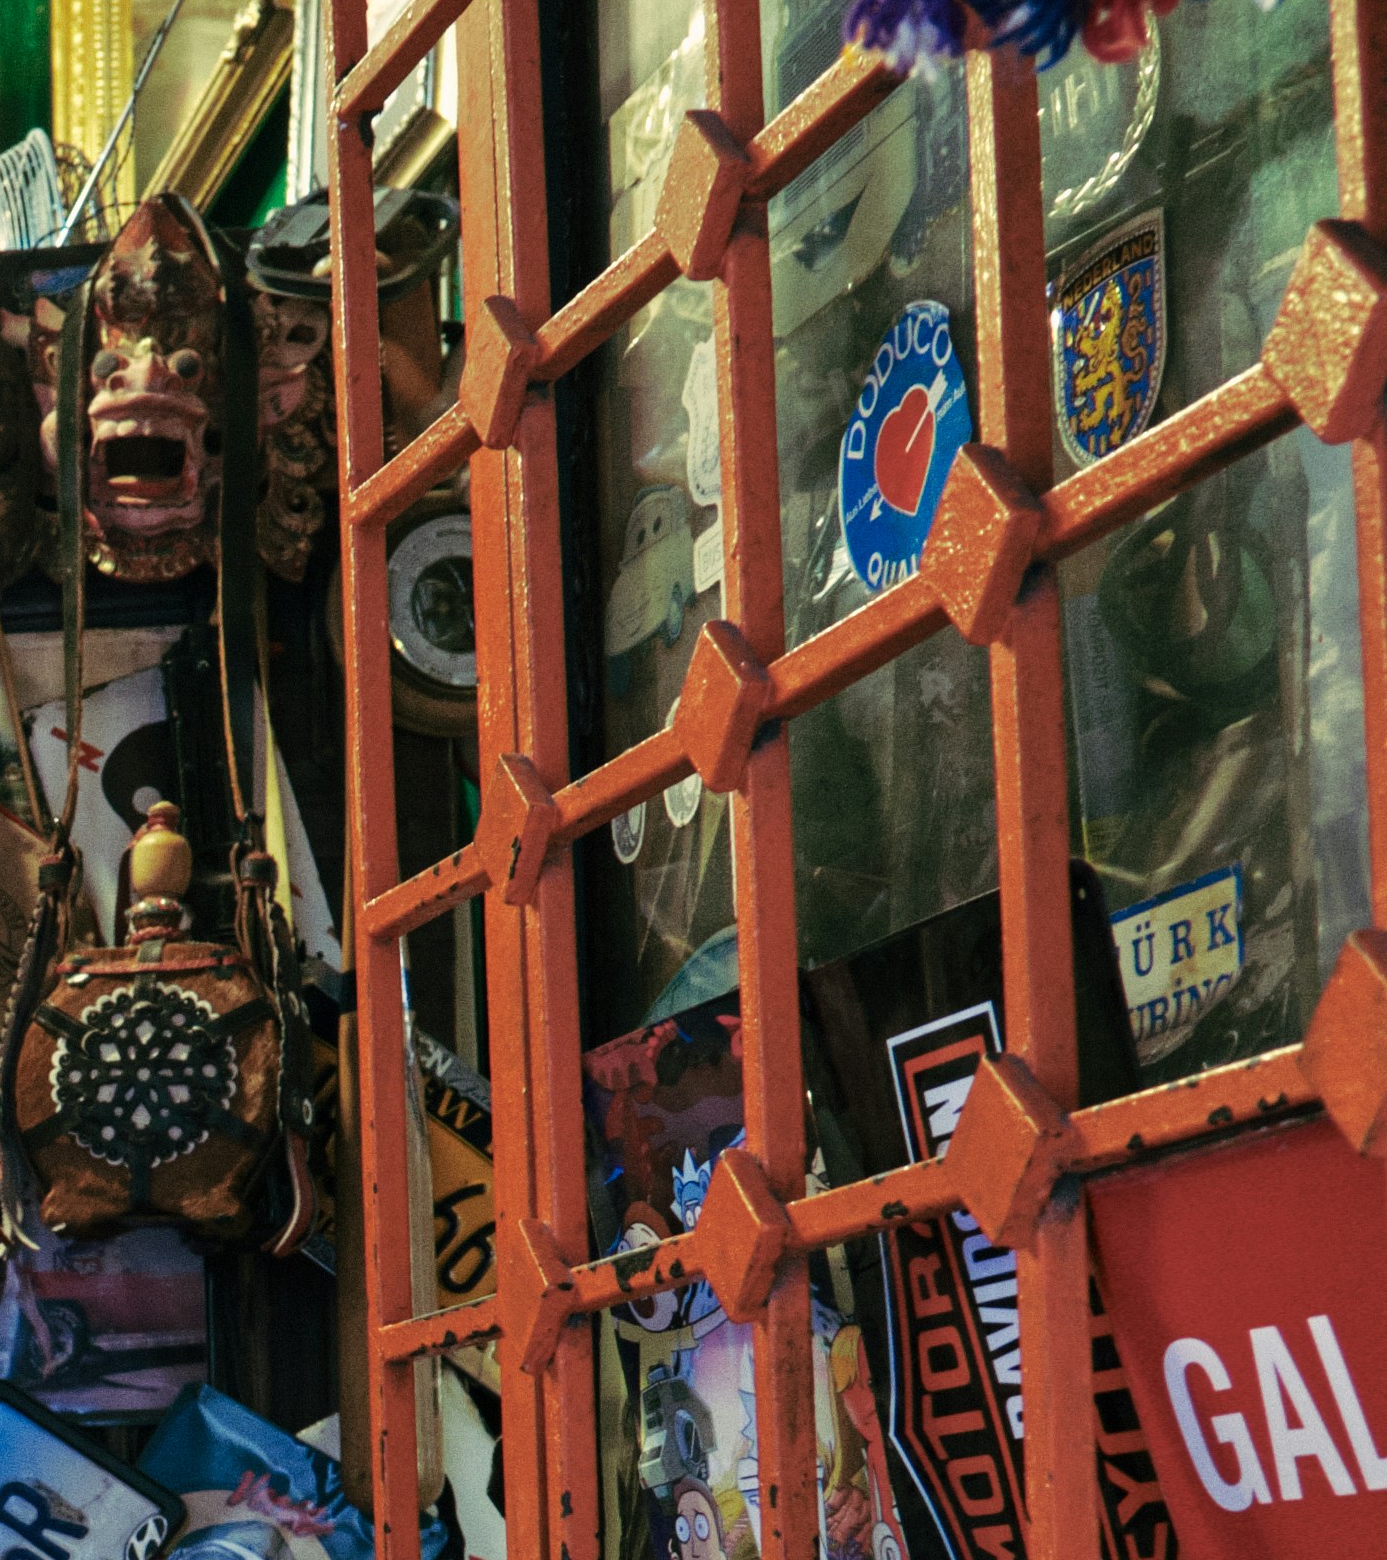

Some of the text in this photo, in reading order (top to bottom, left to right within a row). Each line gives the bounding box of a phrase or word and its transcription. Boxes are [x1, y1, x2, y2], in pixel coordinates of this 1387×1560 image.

[1062, 232, 1155, 307] NEDERLAND
[847, 313, 952, 459] DODUCO
[1119, 902, 1235, 978] ÜRK
